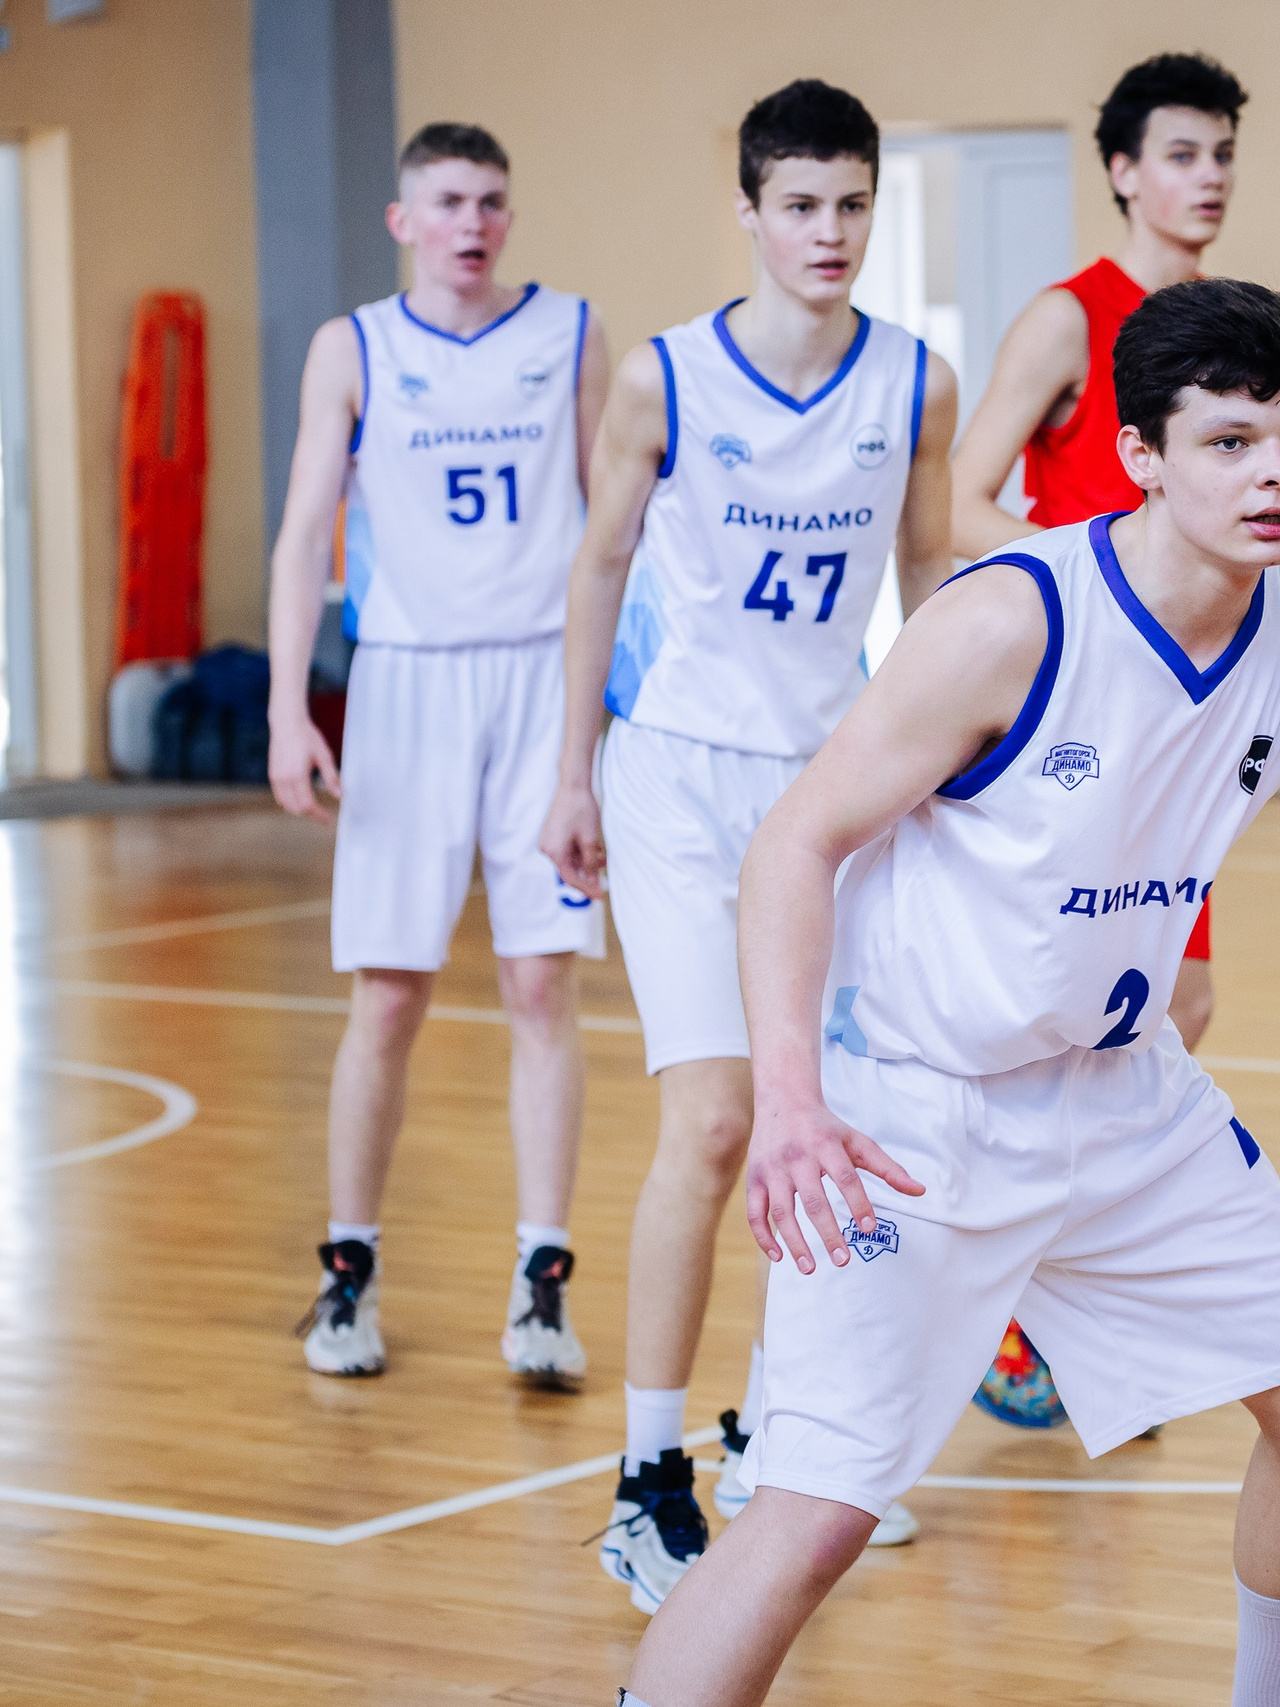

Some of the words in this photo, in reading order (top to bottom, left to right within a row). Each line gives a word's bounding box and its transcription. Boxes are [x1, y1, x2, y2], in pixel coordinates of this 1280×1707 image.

[410, 424, 543, 449] ДИНАМО
[447, 465, 518, 525] 51
[723, 503, 873, 531] ДИНАМО
[743, 550, 848, 622] 47
[1052, 760, 1091, 772] ДИНАМО
[1090, 968, 1150, 1050] 2
[851, 1231, 891, 1245] ДИНАМО
